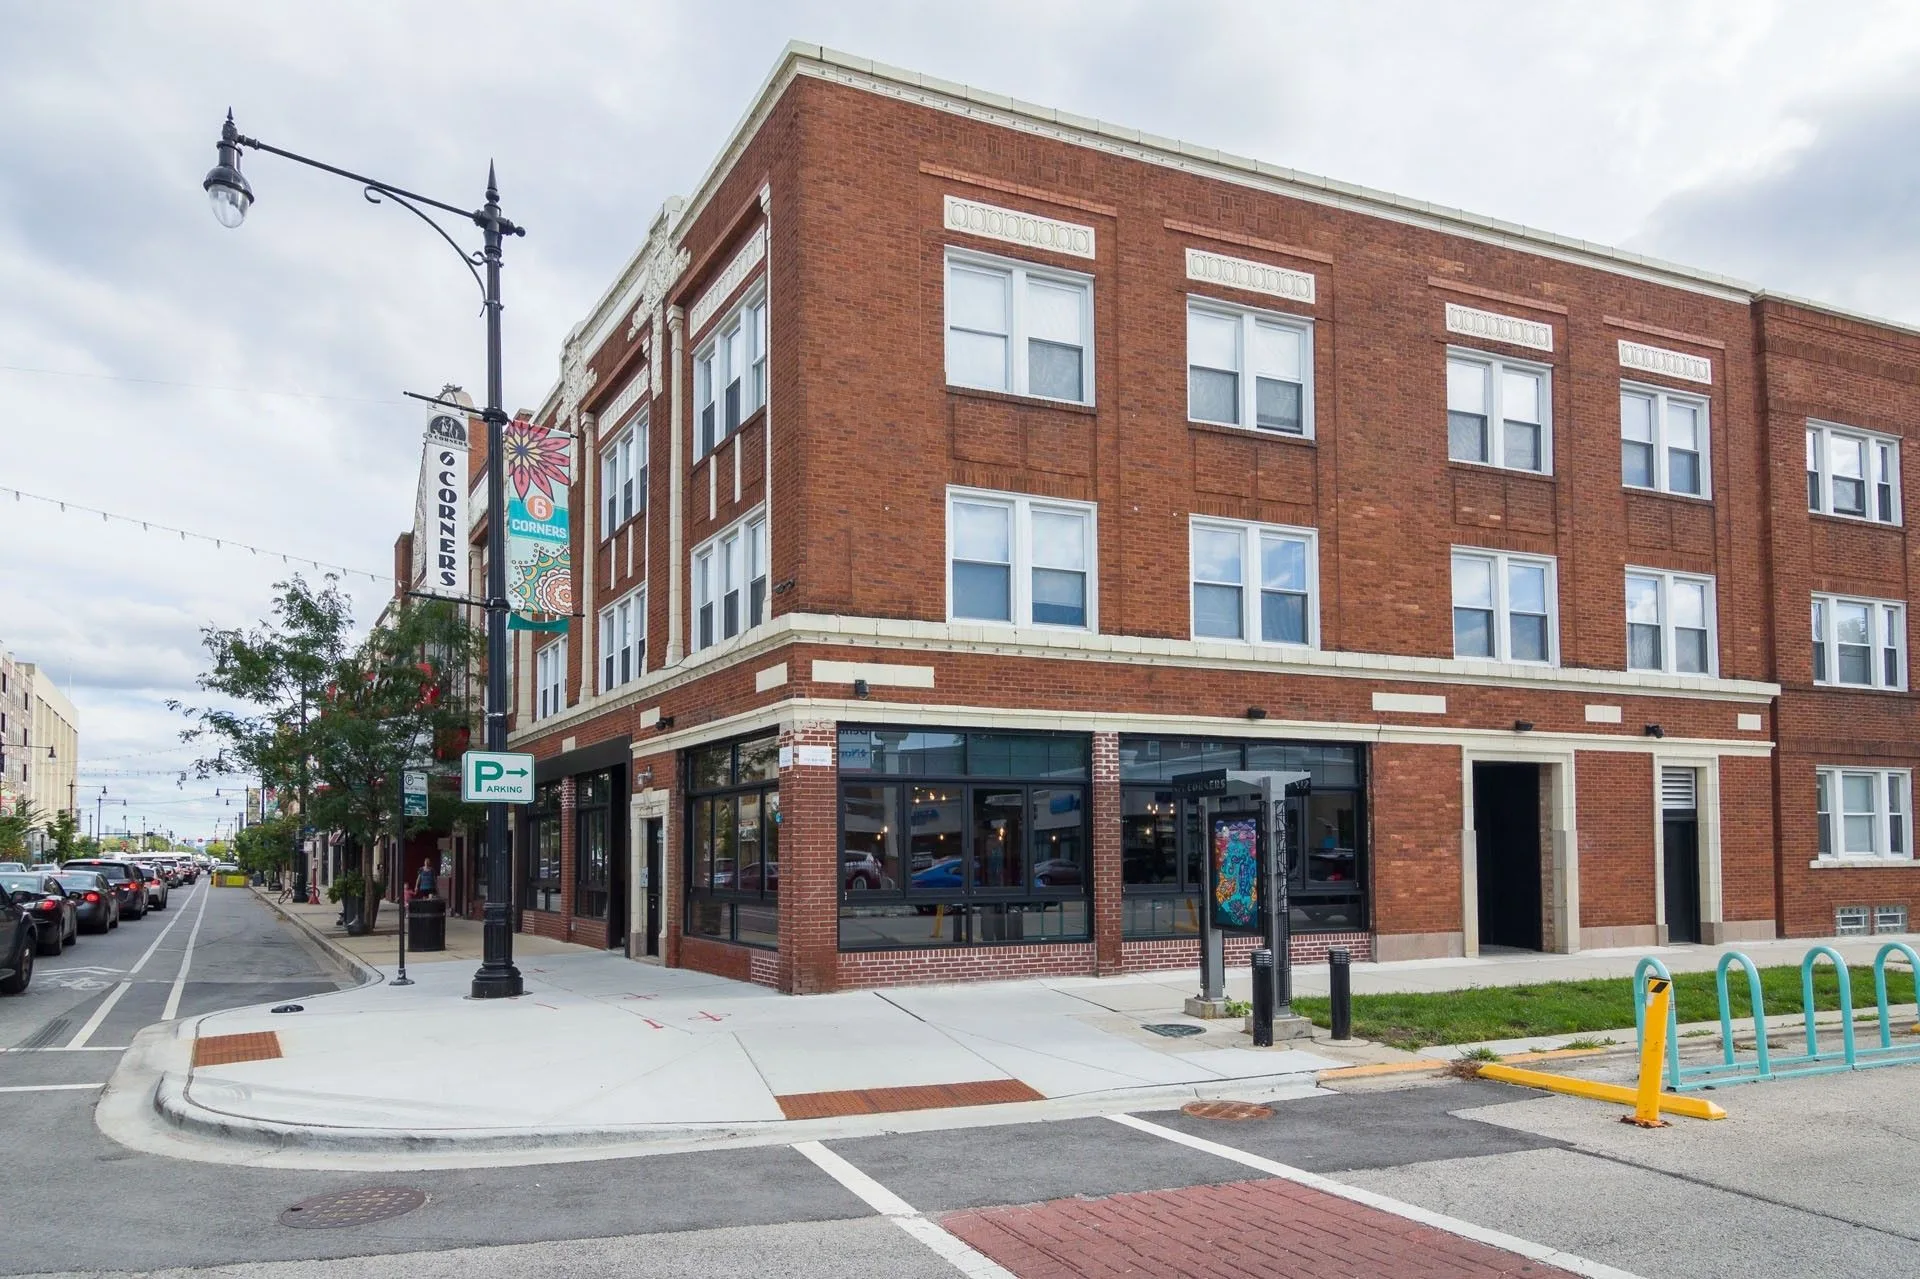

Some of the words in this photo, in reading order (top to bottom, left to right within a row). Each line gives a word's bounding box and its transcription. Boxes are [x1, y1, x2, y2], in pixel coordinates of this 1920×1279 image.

[434, 434, 468, 447] CORNERS
[440, 451, 455, 466] 6
[533, 498, 547, 518] 6
[438, 471, 458, 587] CORNERS
[512, 519, 567, 539] CORNERS
